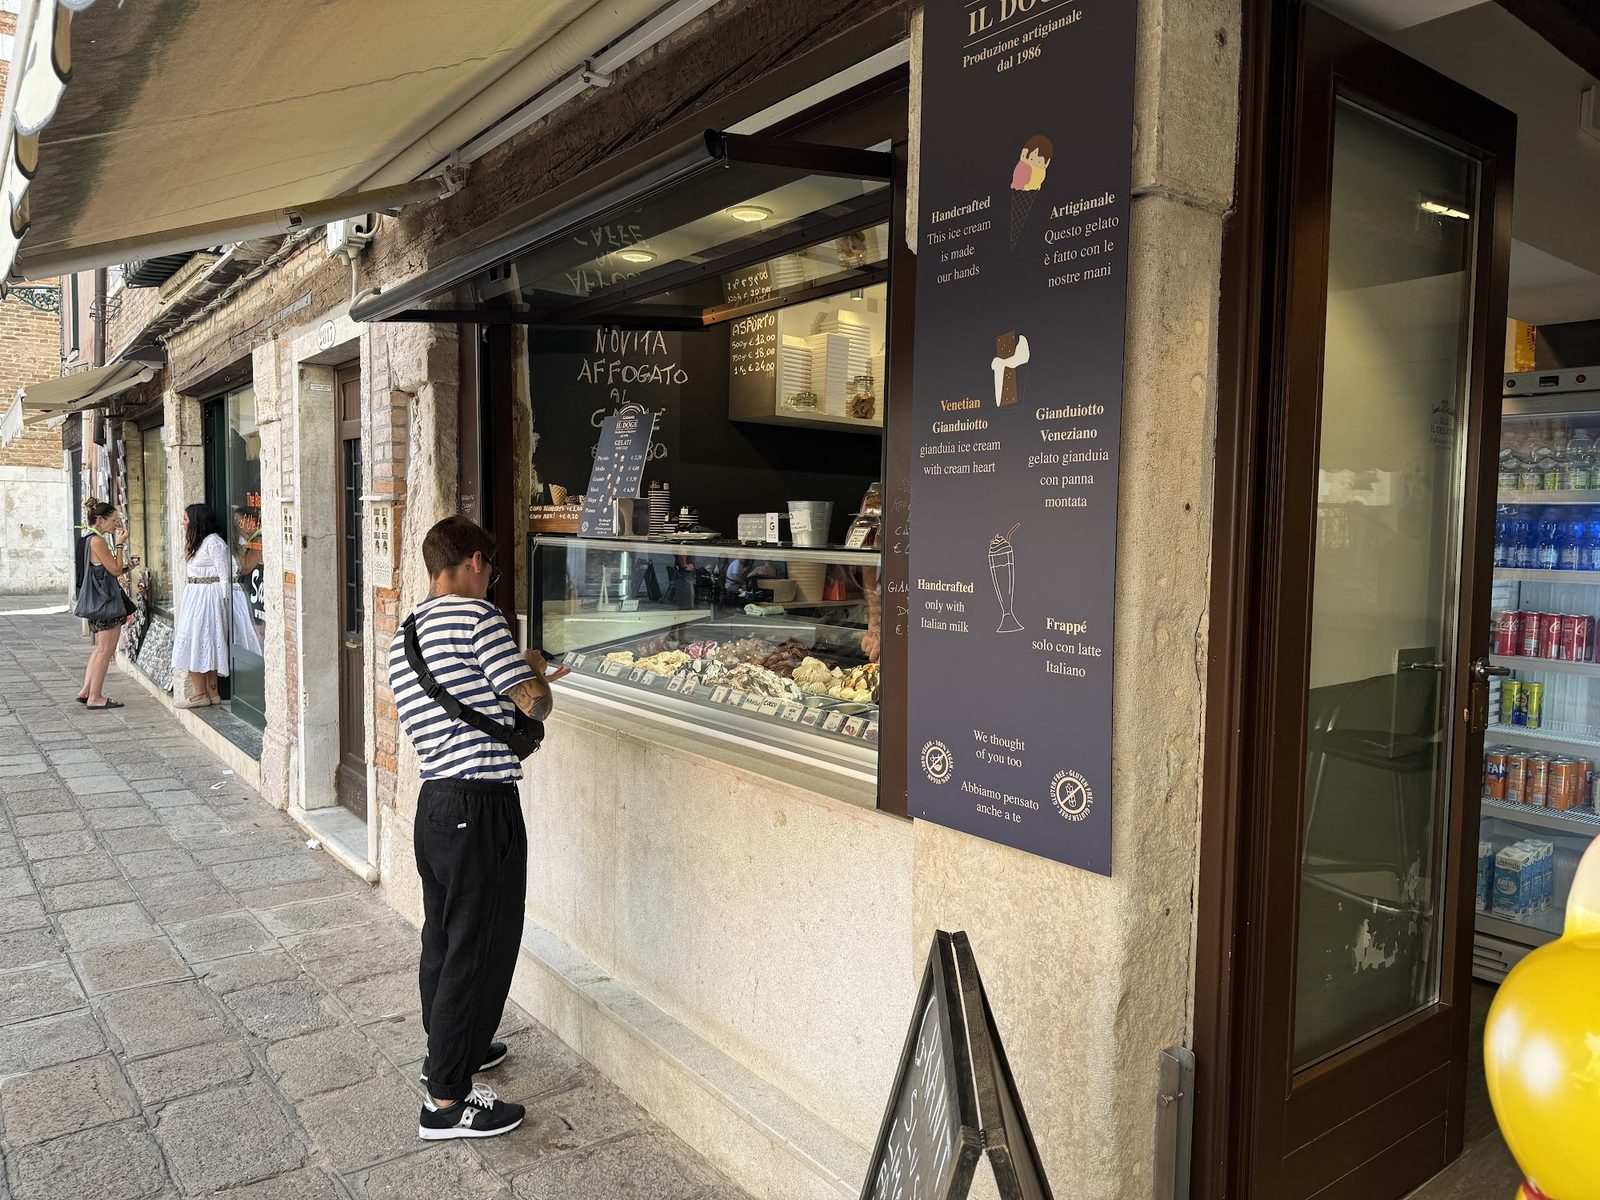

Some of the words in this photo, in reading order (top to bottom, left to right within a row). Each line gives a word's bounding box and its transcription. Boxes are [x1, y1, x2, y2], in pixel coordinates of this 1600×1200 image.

[967, 6, 993, 37] IL
[999, 0, 1054, 23] DO
[962, 35, 1020, 69] Produzione
[1022, 9, 1083, 44] artigianale
[996, 55, 1014, 73] dal
[1016, 44, 1042, 66] 1986
[931, 196, 991, 225] Handcrafted
[1050, 191, 1116, 220] Artigianale
[927, 229, 946, 246] This
[948, 224, 962, 240] ice
[963, 220, 992, 237] cream
[1044, 225, 1082, 245] Questo
[1085, 215, 1120, 237] gelato
[941, 250, 949, 263] is
[950, 244, 975, 261] made
[1043, 253, 1051, 266] è
[1053, 245, 1078, 264] fatto
[1080, 244, 1100, 258] con
[1104, 239, 1115, 253] le
[936, 271, 952, 285] our
[953, 263, 980, 281] hands
[1048, 269, 1081, 288] nostre
[1083, 262, 1112, 281] mani
[732, 313, 775, 337] ASPORTO
[577, 358, 689, 385] AFFOGATO
[610, 388, 631, 404] AL
[940, 397, 981, 412] Venetian
[1035, 404, 1104, 421] Gianduiotto
[932, 418, 988, 434] Gianduiotto
[1040, 426, 1098, 442] Veneziano
[919, 441, 956, 458] gianduia
[957, 441, 972, 453] ice
[973, 440, 1001, 452] cream
[1027, 452, 1060, 468] gelato
[1061, 449, 1109, 466] gianduia
[923, 462, 942, 475] with
[943, 464, 971, 475] cream
[972, 461, 996, 473] heart
[1040, 475, 1059, 486] con
[1061, 473, 1094, 489] panna
[1045, 496, 1088, 508] montata
[917, 578, 974, 594] Handcrafted
[924, 600, 944, 613] only
[945, 601, 965, 613] with
[920, 617, 947, 631] Italian
[949, 619, 969, 633] milk
[1046, 617, 1088, 636] Frappé
[1032, 638, 1053, 652] solo
[1055, 642, 1076, 655] con
[1078, 642, 1102, 657] latte
[1046, 660, 1086, 678] Italiano
[973, 729, 988, 743] We
[990, 732, 1025, 752] thought
[975, 749, 986, 760] of
[987, 752, 1005, 765] you
[1006, 756, 1023, 768] too
[960, 780, 1001, 801] Abbiamo
[1003, 793, 1040, 811] pensato
[976, 802, 1003, 818] anche
[1004, 811, 1010, 820] a
[1012, 812, 1022, 823] te
